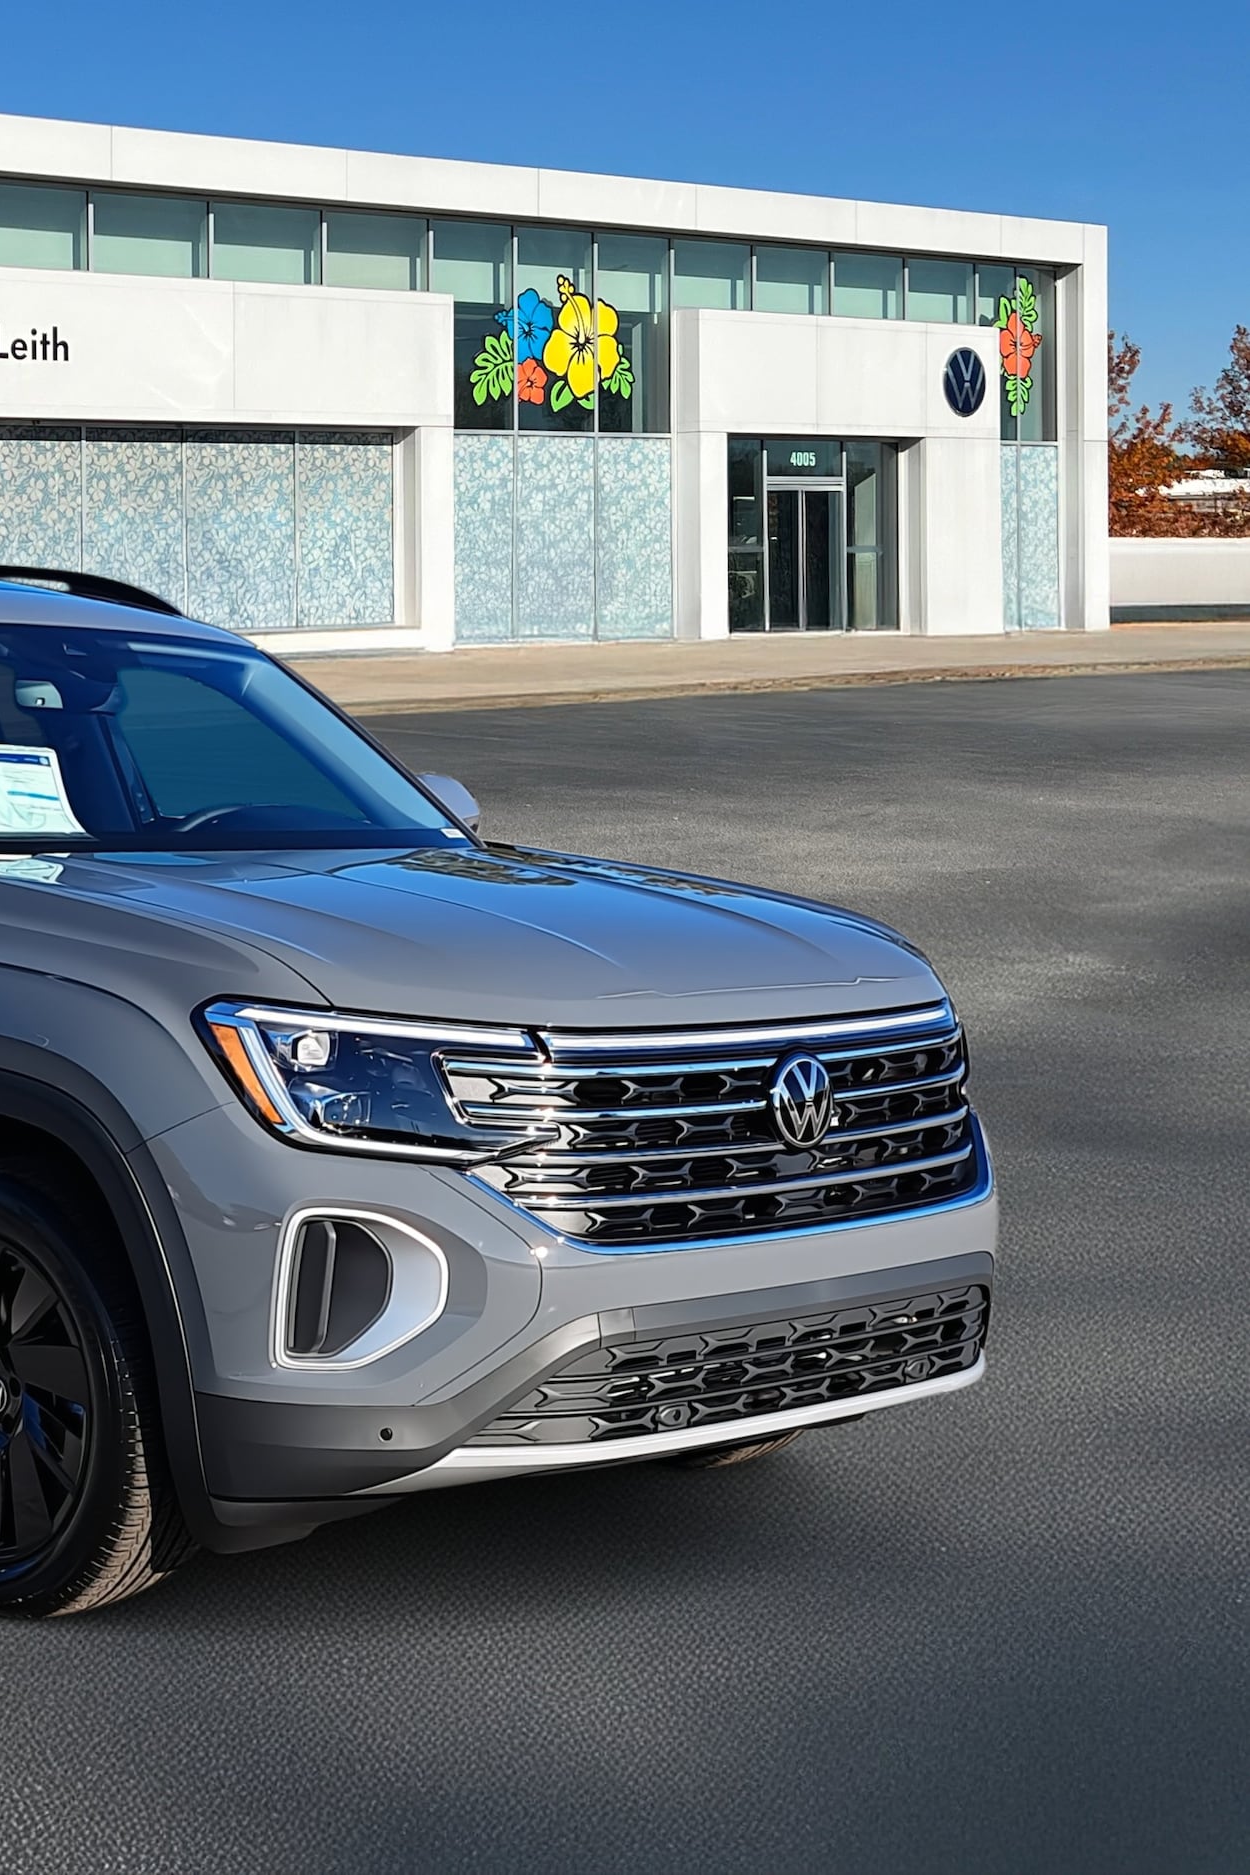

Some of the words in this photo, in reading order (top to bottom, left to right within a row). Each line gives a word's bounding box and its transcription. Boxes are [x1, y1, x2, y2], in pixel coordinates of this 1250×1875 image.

[944, 347, 986, 416] VW
[790, 451, 816, 467] 4005
[775, 1058, 830, 1146] VW
